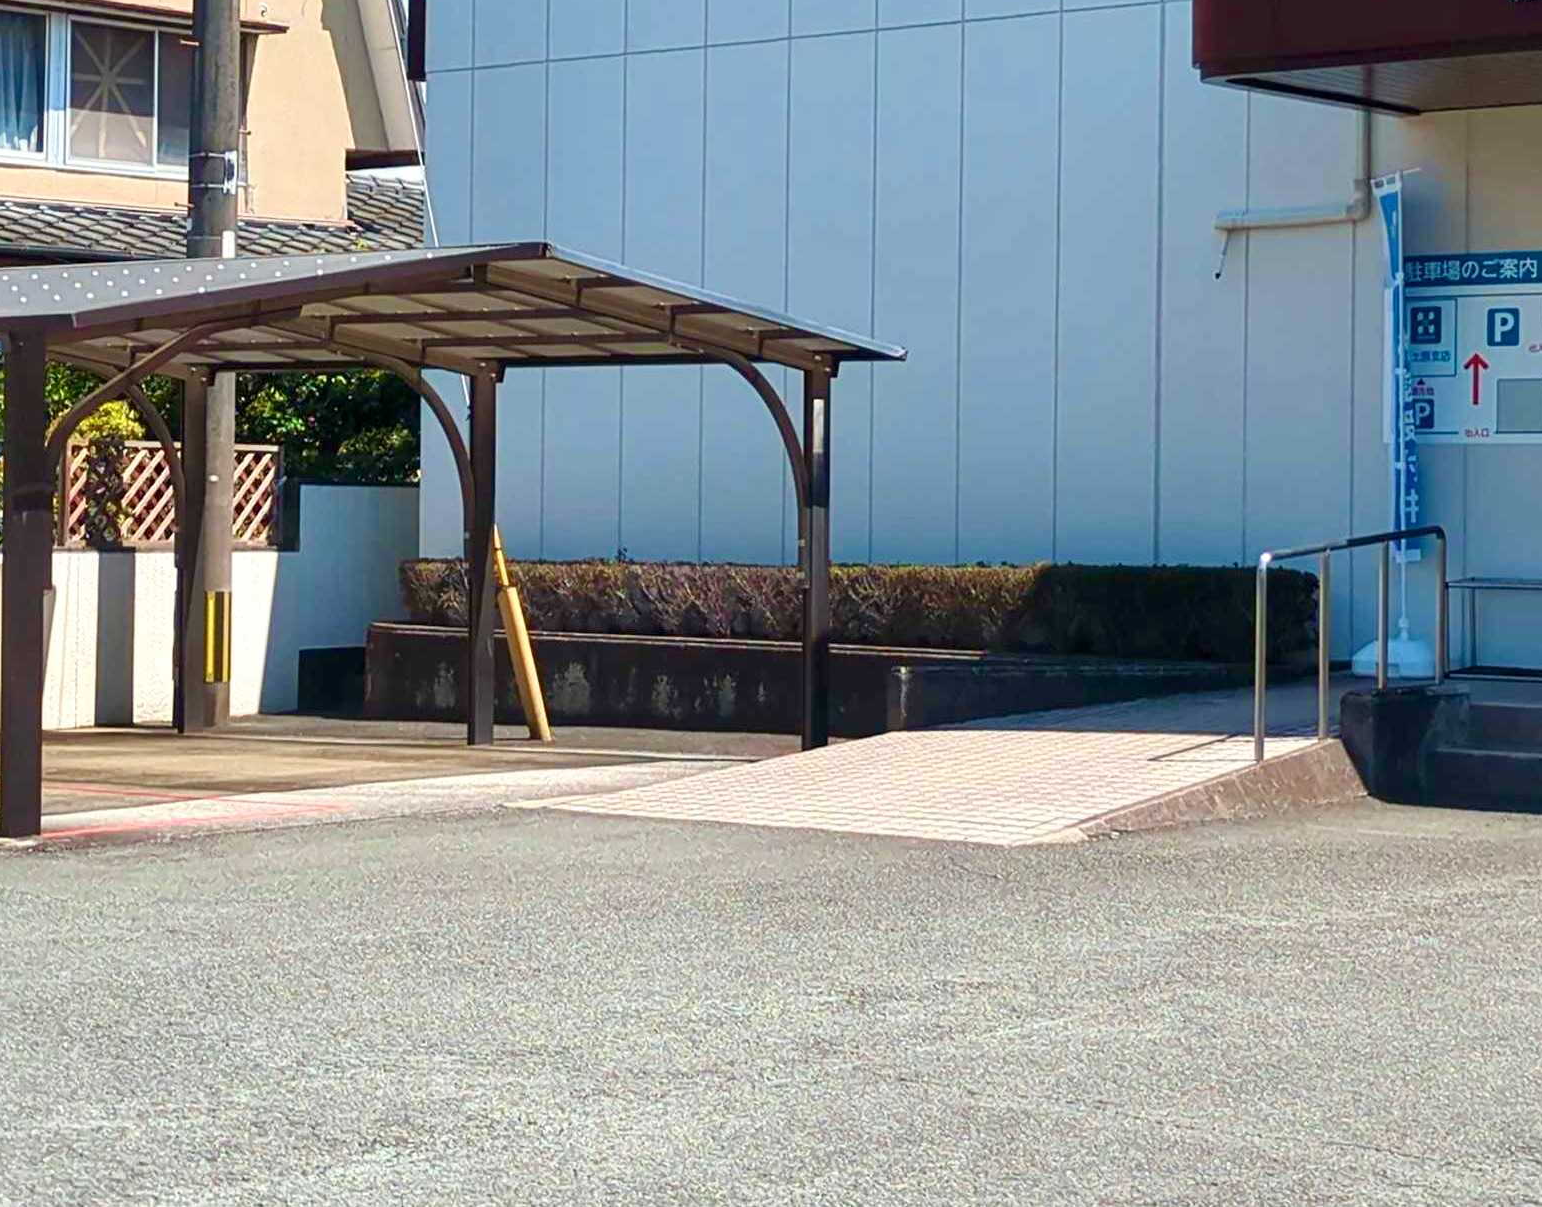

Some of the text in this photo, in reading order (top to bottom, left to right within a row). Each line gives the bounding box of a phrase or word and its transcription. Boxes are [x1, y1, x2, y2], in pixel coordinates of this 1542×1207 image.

[1405, 258, 1538, 281] 駐車場のご案内
[1494, 312, 1515, 343] P
[1415, 401, 1431, 426] P
